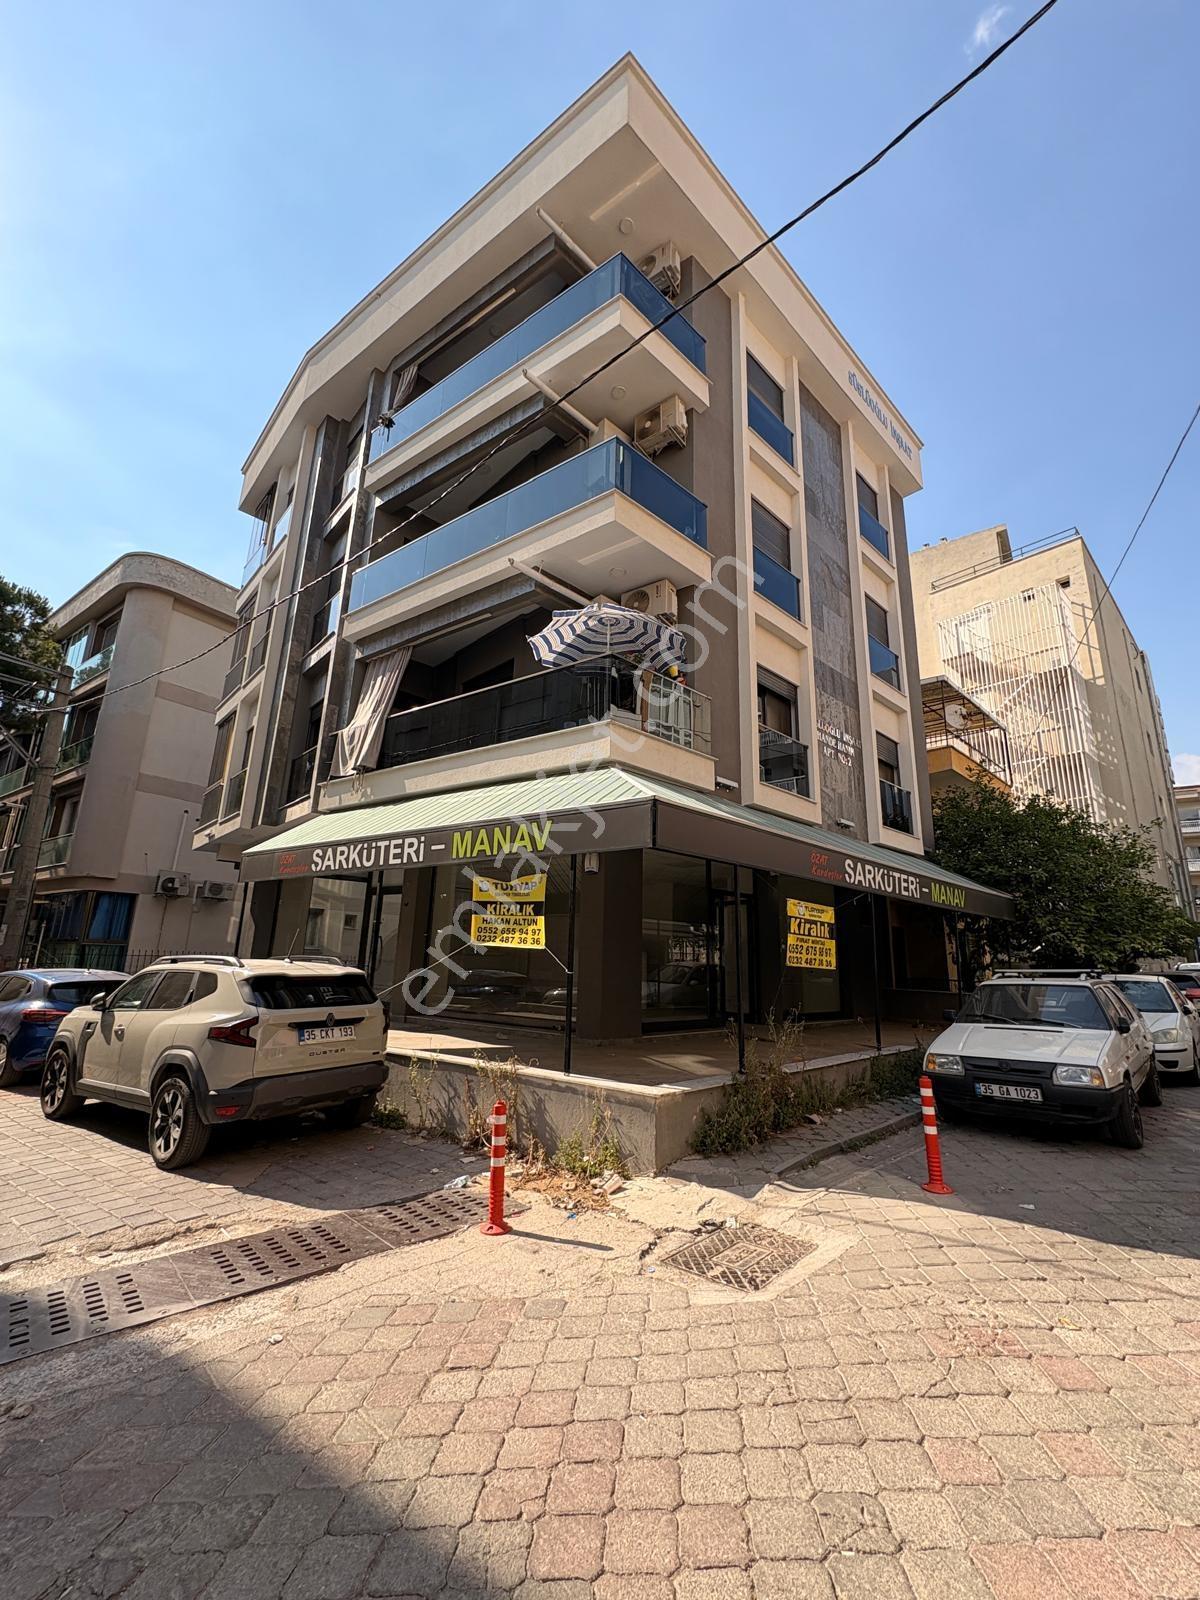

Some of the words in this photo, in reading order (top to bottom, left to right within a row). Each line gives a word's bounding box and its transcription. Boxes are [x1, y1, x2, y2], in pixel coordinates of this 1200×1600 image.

[451, 821, 553, 860] MANAV
[931, 881, 966, 908] MANAV
[486, 901, 535, 916] KİRALIK
[482, 917, 511, 926] HAKAN
[512, 917, 538, 926] ALTUN
[790, 917, 830, 939] Kiralık
[477, 926, 498, 935] 0552
[518, 928, 529, 936] 94
[531, 928, 542, 937] 97
[476, 934, 497, 943] 0232
[499, 936, 515, 944] 487
[517, 936, 528, 945] 36
[530, 937, 541, 945] 36
[804, 957, 817, 966] 487
[305, 1030, 316, 1040] 35
[320, 1028, 335, 1039] CKT
[339, 1026, 353, 1037] 193
[981, 1084, 994, 1095] 35
[998, 1085, 1011, 1096] GA
[1014, 1087, 1039, 1100] 1023
